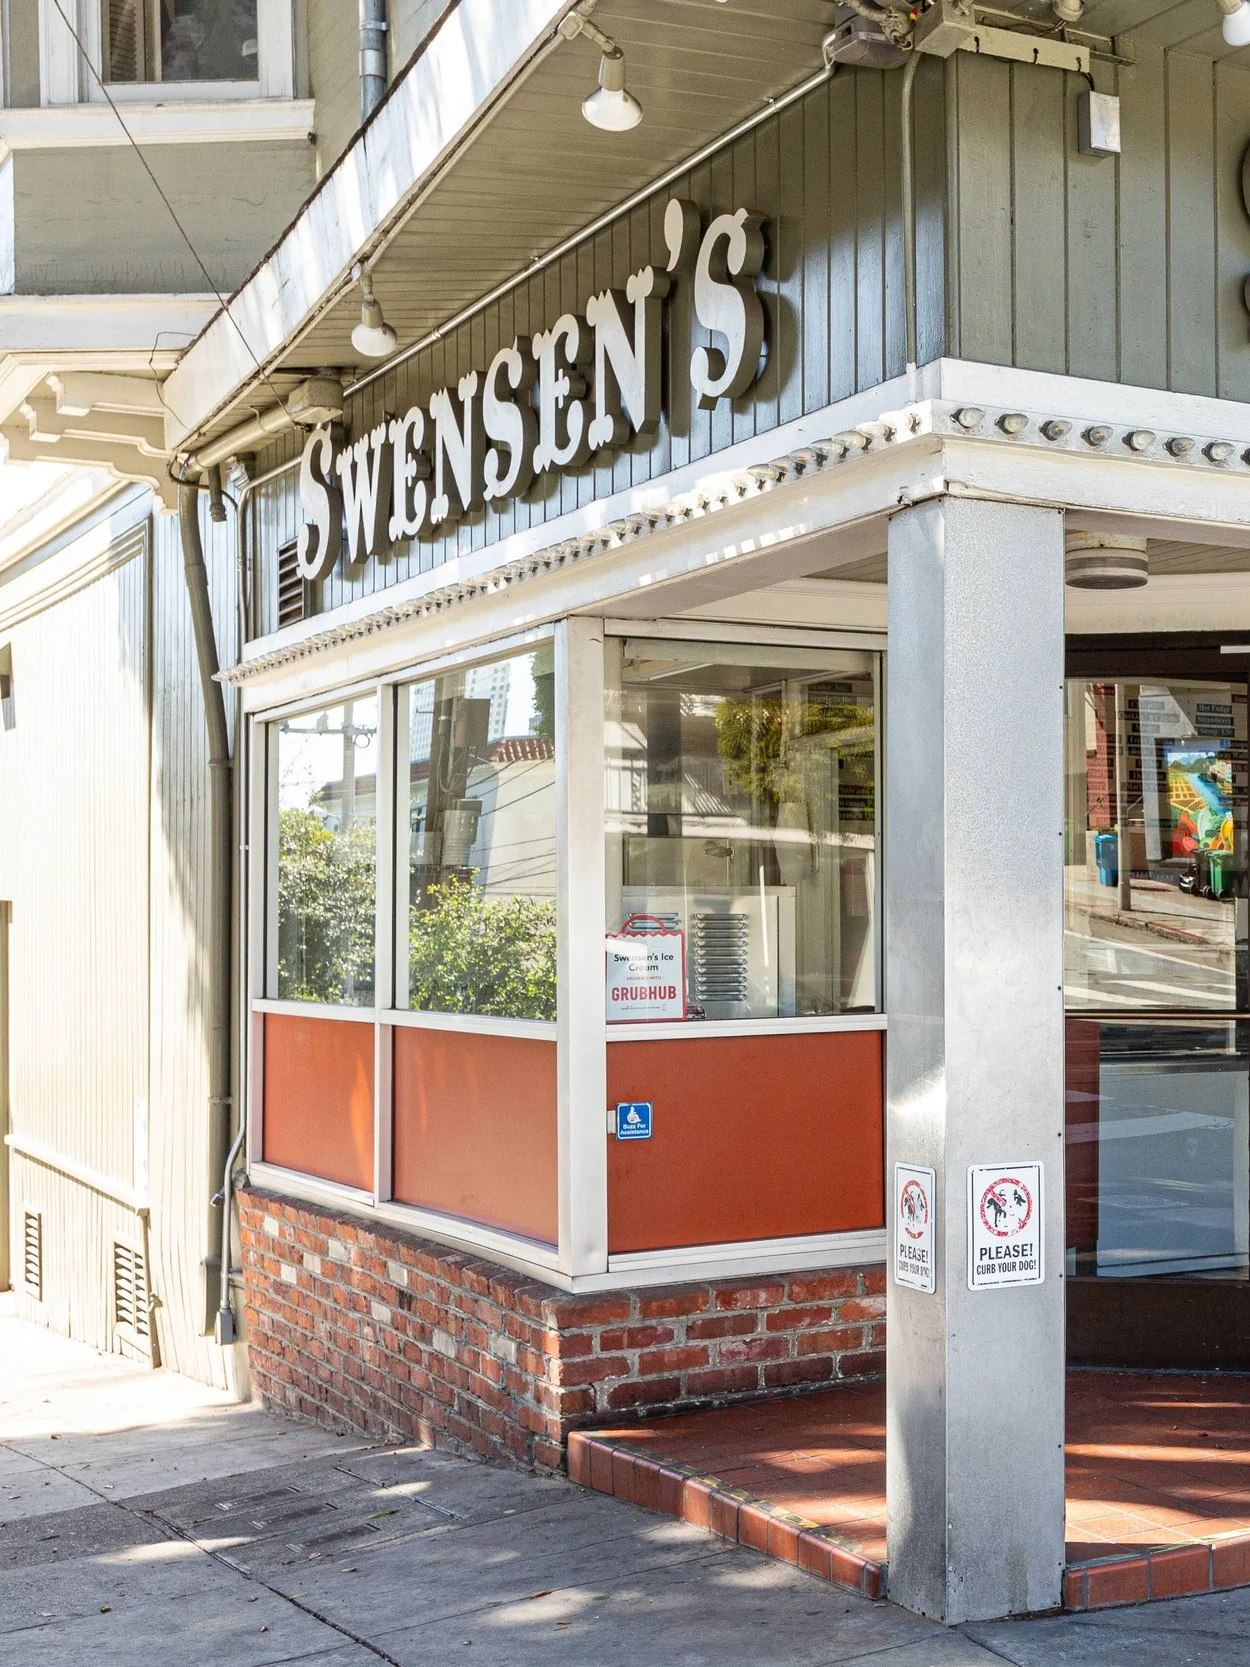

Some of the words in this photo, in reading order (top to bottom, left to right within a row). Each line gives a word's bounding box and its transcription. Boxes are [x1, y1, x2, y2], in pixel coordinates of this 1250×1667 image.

[1212, 705, 1230, 714] Fudge
[661, 952, 674, 961] Ice
[612, 986, 676, 1001] GRUBHUB
[900, 1244, 928, 1264] PLEASE!
[980, 1243, 1033, 1261] PLEASE!
[976, 1264, 996, 1275] CURB
[998, 1262, 1017, 1273] YOUR
[1019, 1260, 1037, 1271] DOG!
